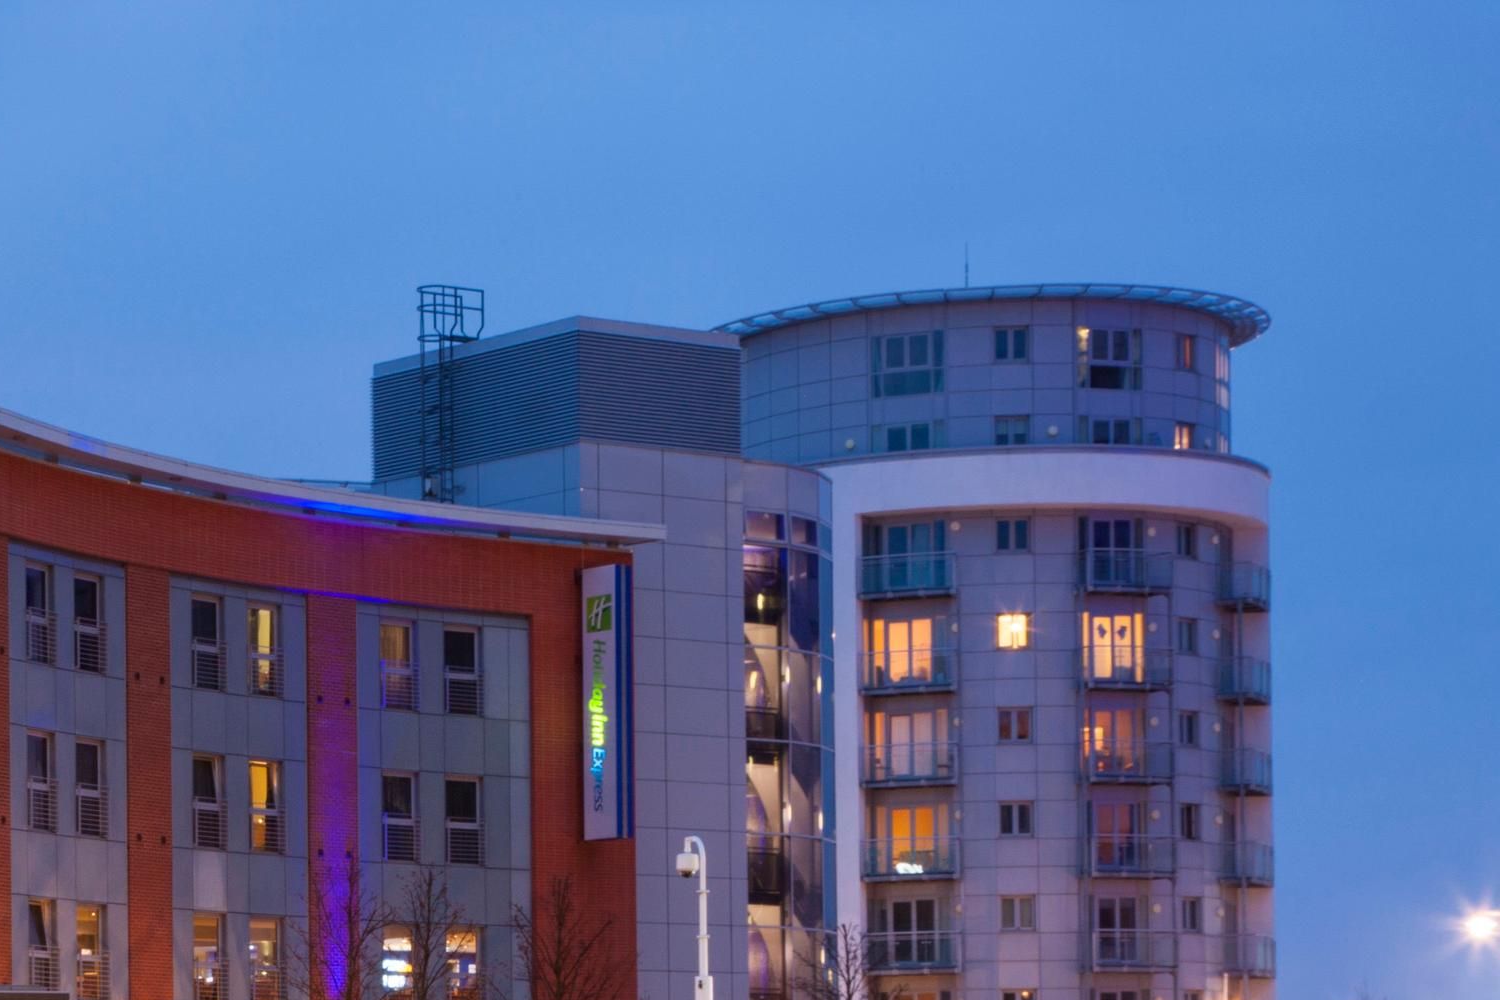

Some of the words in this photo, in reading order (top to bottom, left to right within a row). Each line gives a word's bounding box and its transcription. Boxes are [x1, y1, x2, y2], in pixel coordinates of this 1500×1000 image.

[588, 640, 606, 713] Holiday
[591, 713, 608, 746] Inn
[590, 748, 606, 812] Express
